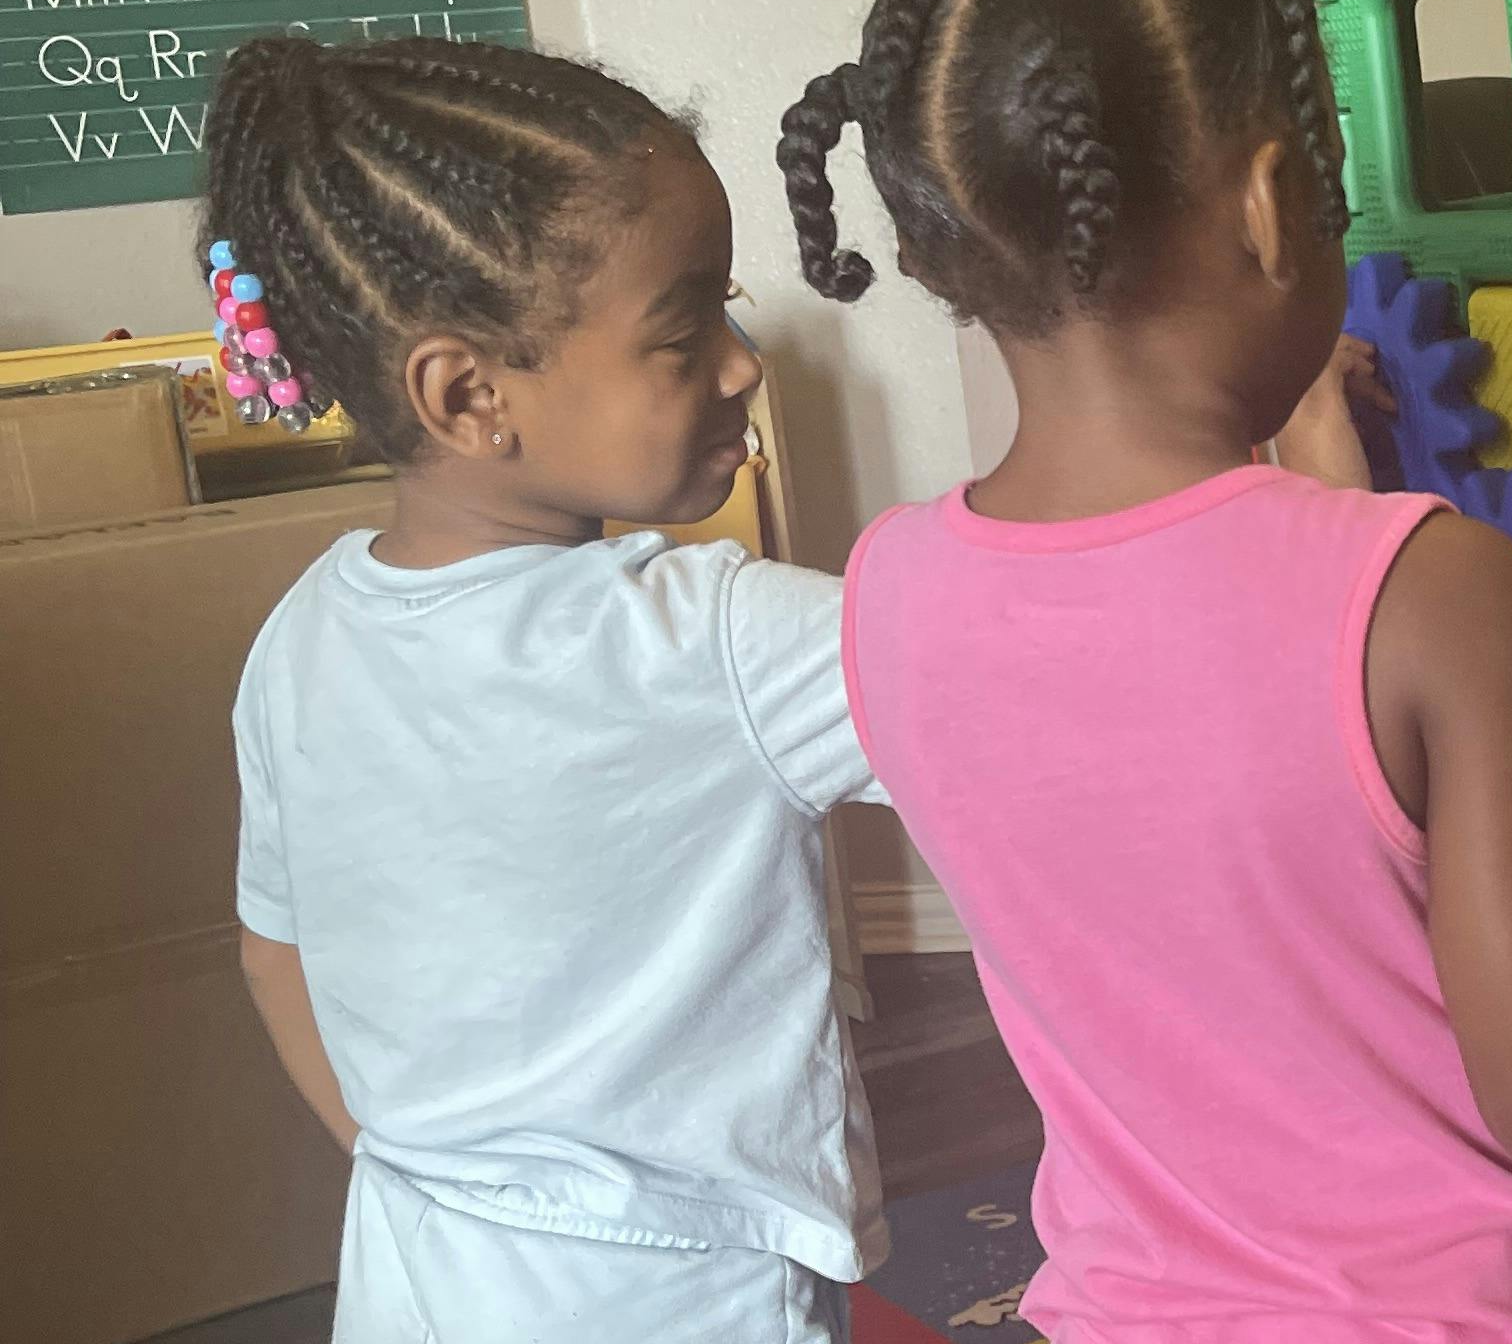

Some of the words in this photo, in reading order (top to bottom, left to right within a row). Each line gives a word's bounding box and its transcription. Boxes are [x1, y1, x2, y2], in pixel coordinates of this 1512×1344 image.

[38, 35, 138, 103] Qq
[148, 30, 207, 79] Rr
[48, 111, 119, 162] Vv
[139, 104, 209, 154] W
